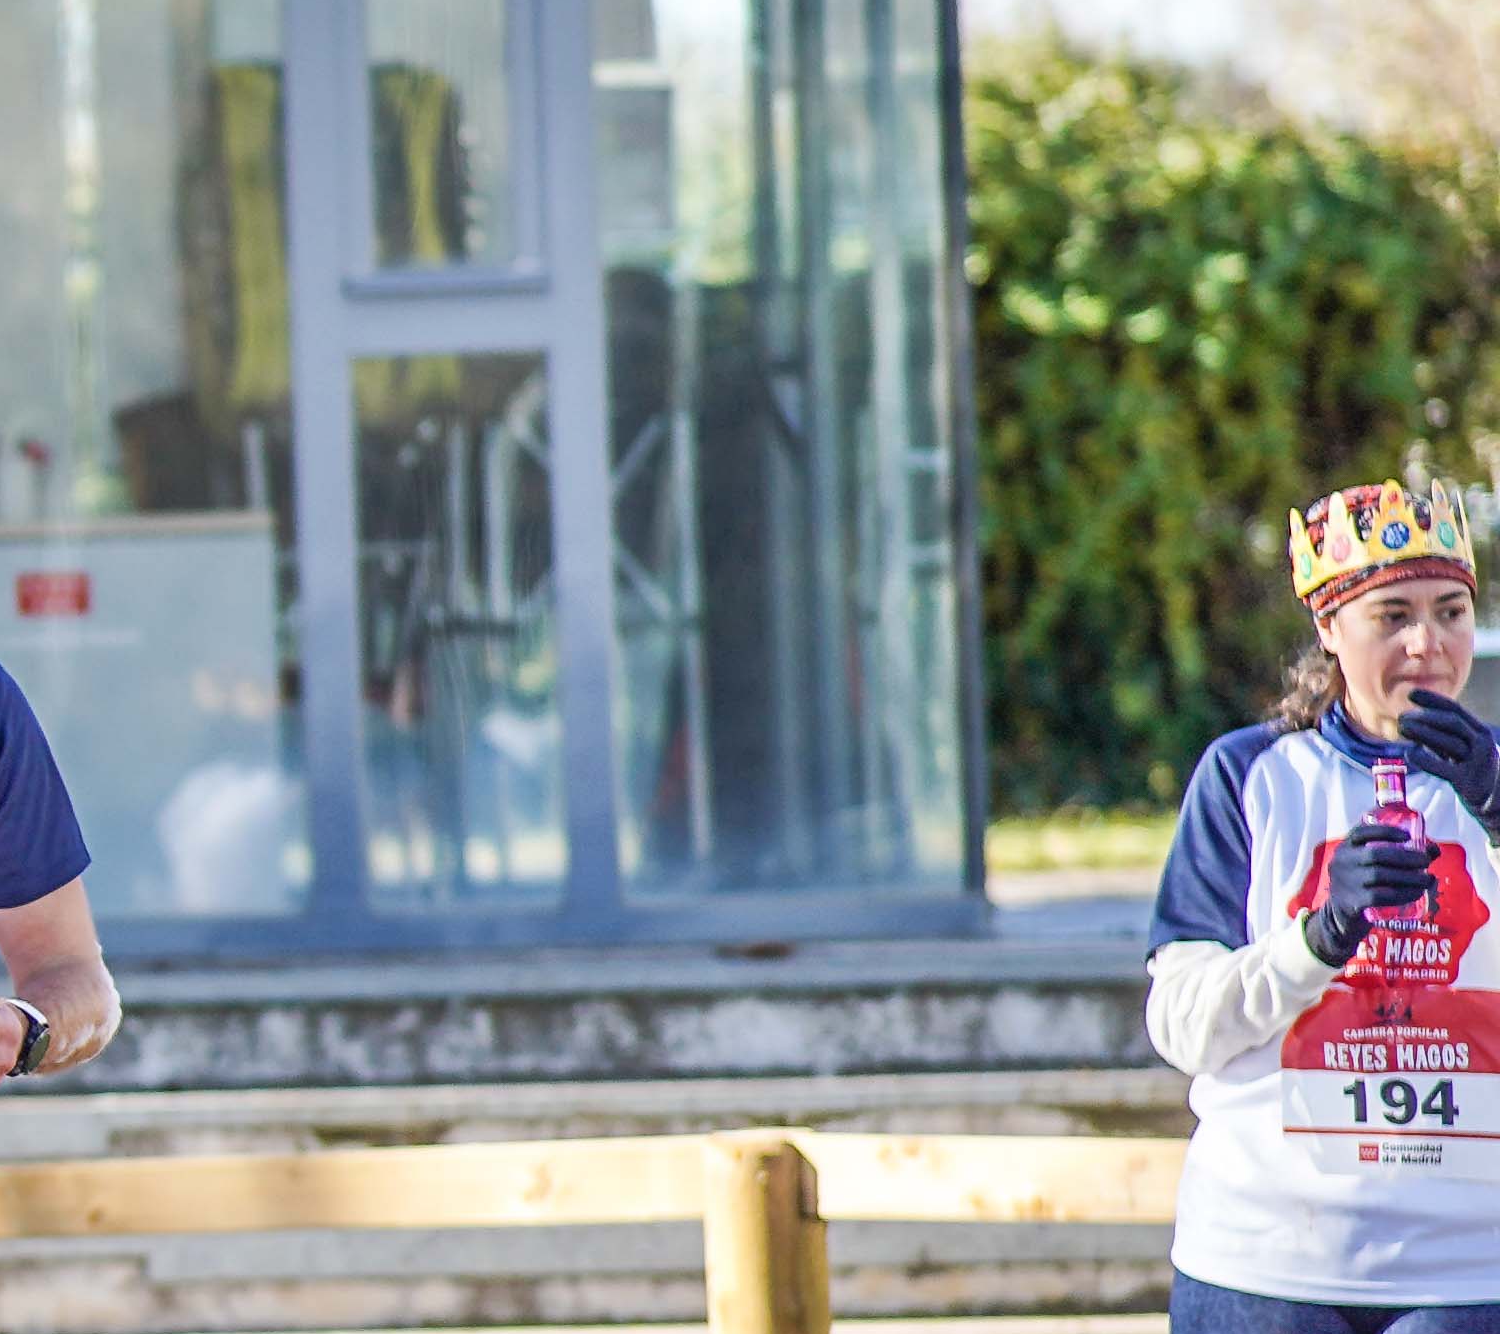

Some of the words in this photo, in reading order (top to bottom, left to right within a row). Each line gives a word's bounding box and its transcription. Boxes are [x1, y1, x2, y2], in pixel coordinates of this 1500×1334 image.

[1385, 937, 1452, 966] MAGOS
[1323, 1041, 1389, 1071] REYES
[1396, 1041, 1470, 1071] MAGOS
[1343, 1077, 1460, 1126] 194
[1381, 1142, 1443, 1154] Comunidad
[1401, 1153, 1442, 1165] Madrid
